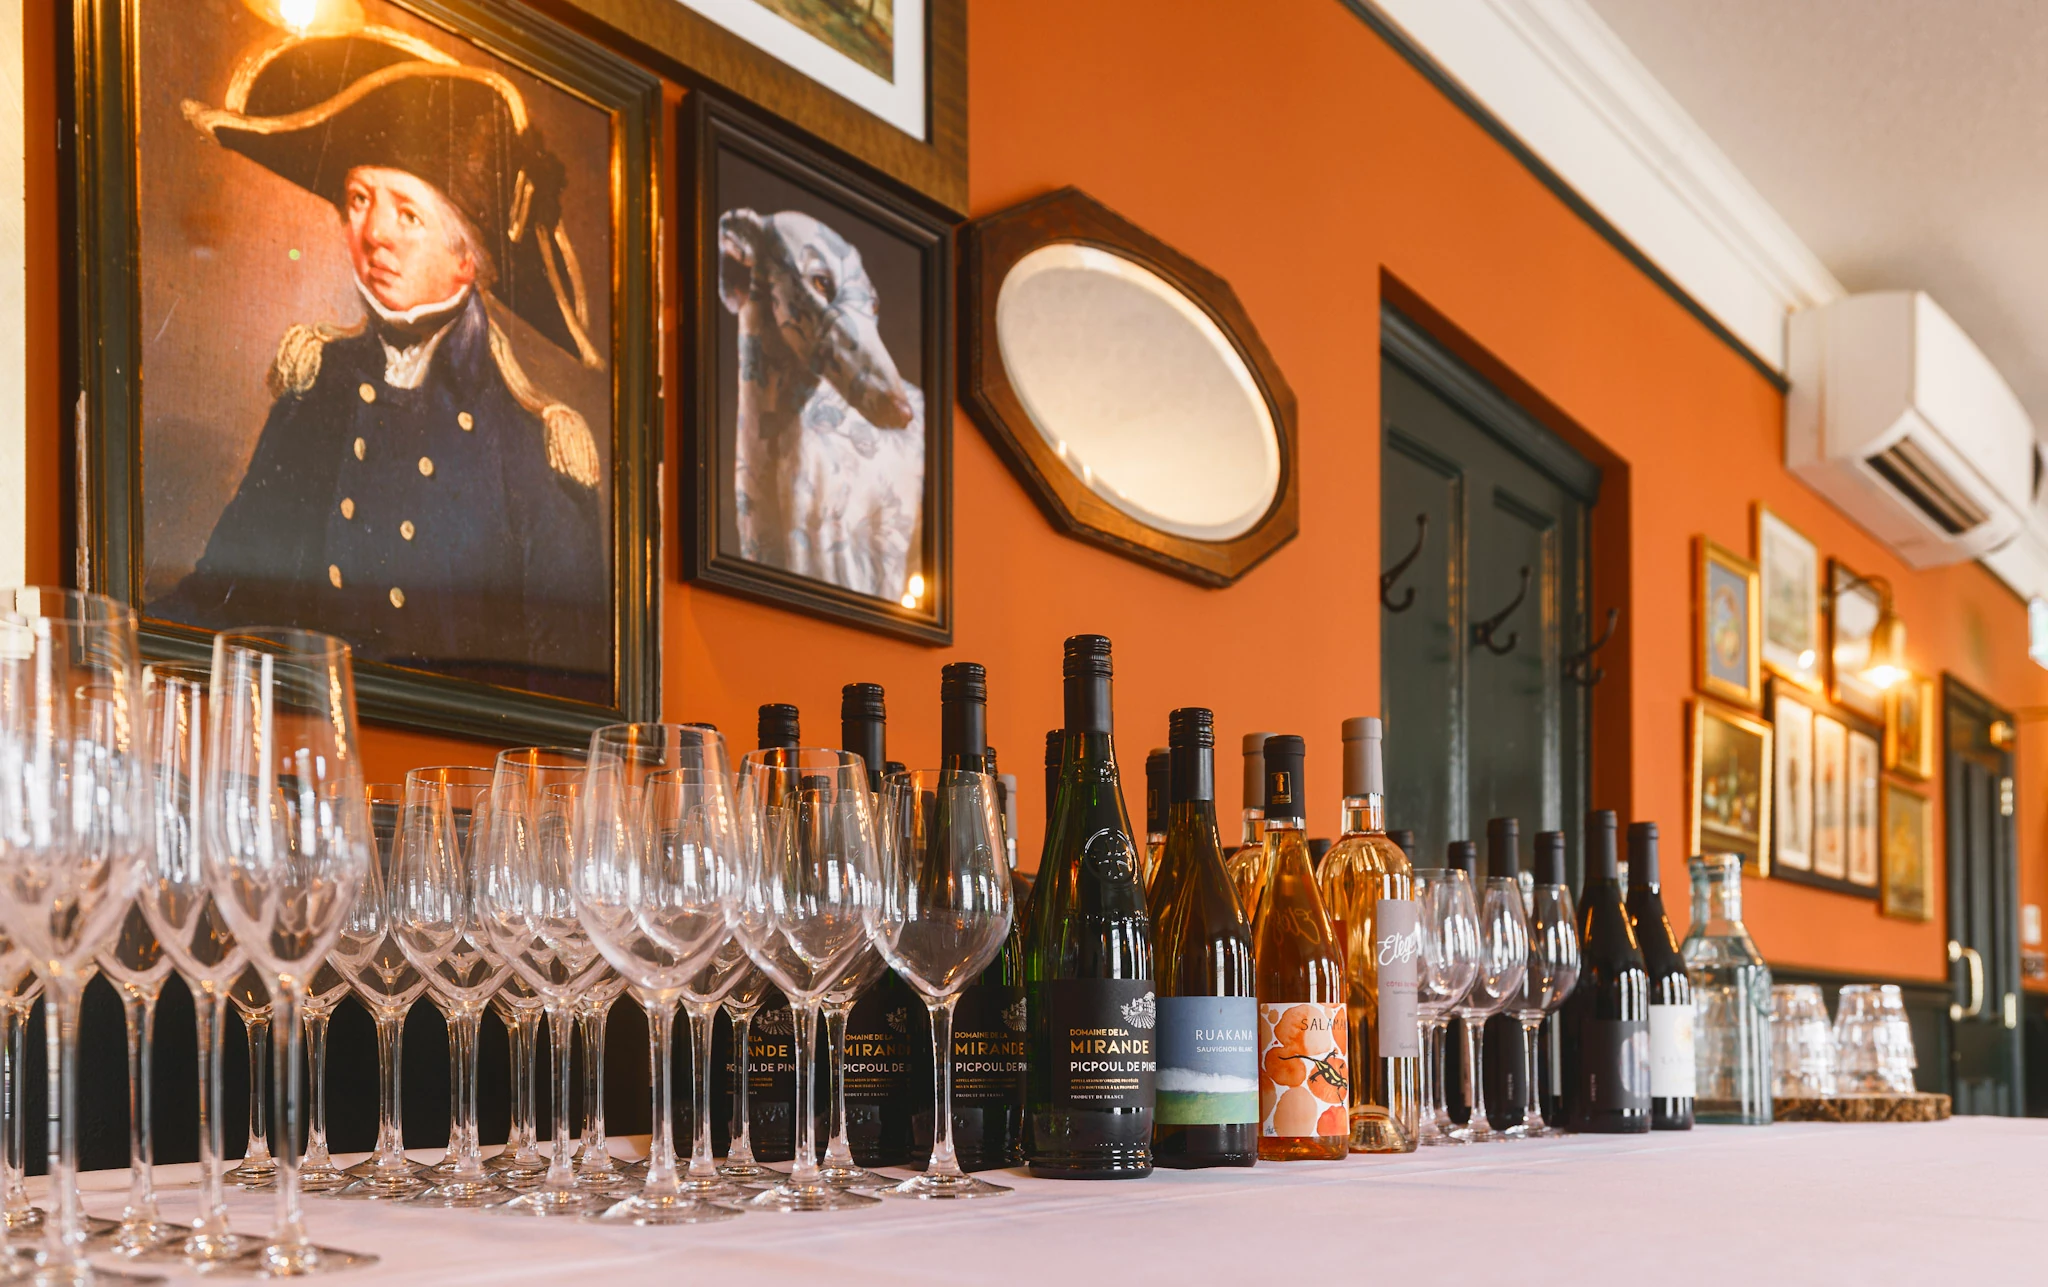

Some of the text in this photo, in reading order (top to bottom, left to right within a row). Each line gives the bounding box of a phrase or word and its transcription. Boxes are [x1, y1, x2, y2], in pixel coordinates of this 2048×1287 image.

[845, 1033, 874, 1041] OMAINE
[955, 1031, 989, 1039] DOMAINE
[1070, 1028, 1129, 1037] DOMAINE DE LA
[1195, 1029, 1253, 1041] RUAKANA
[955, 1041, 1025, 1055] MIRANDE
[1070, 1040, 1149, 1054] MIRANDE
[760, 1063, 774, 1072] DE
[843, 1063, 890, 1073] PICPOUL
[892, 1063, 905, 1073] DE
[955, 1062, 1005, 1072] PICPOUL
[1006, 1062, 1018, 1072] DE
[1070, 1061, 1124, 1072] PICPOUL
[1126, 1061, 1140, 1072] DE
